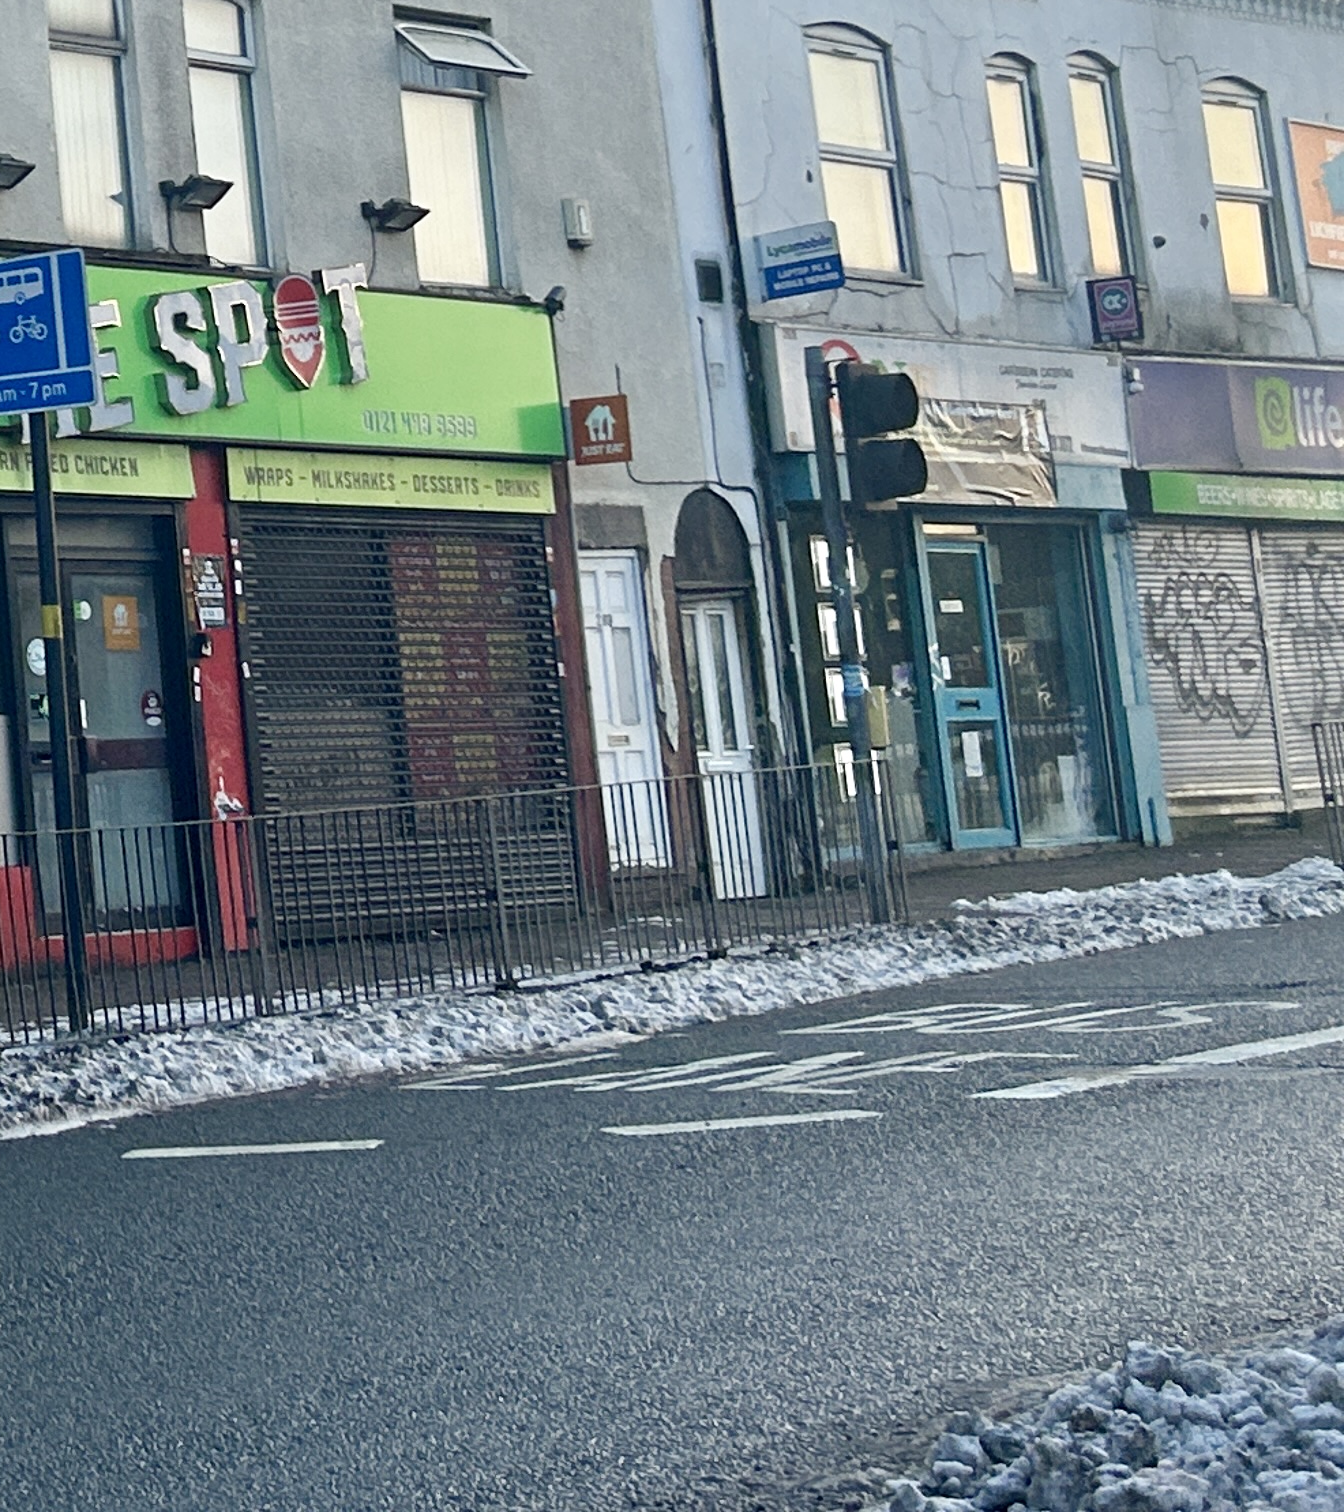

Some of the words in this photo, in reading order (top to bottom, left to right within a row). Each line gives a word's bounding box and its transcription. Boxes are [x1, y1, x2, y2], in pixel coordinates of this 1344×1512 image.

[26, 452, 69, 474] FED
[74, 455, 139, 477] CHICKEN
[244, 466, 293, 486] WRAPS
[312, 469, 395, 491] MILKSHAKES
[412, 474, 480, 495] DESSERTS
[496, 478, 540, 498] DRINKS
